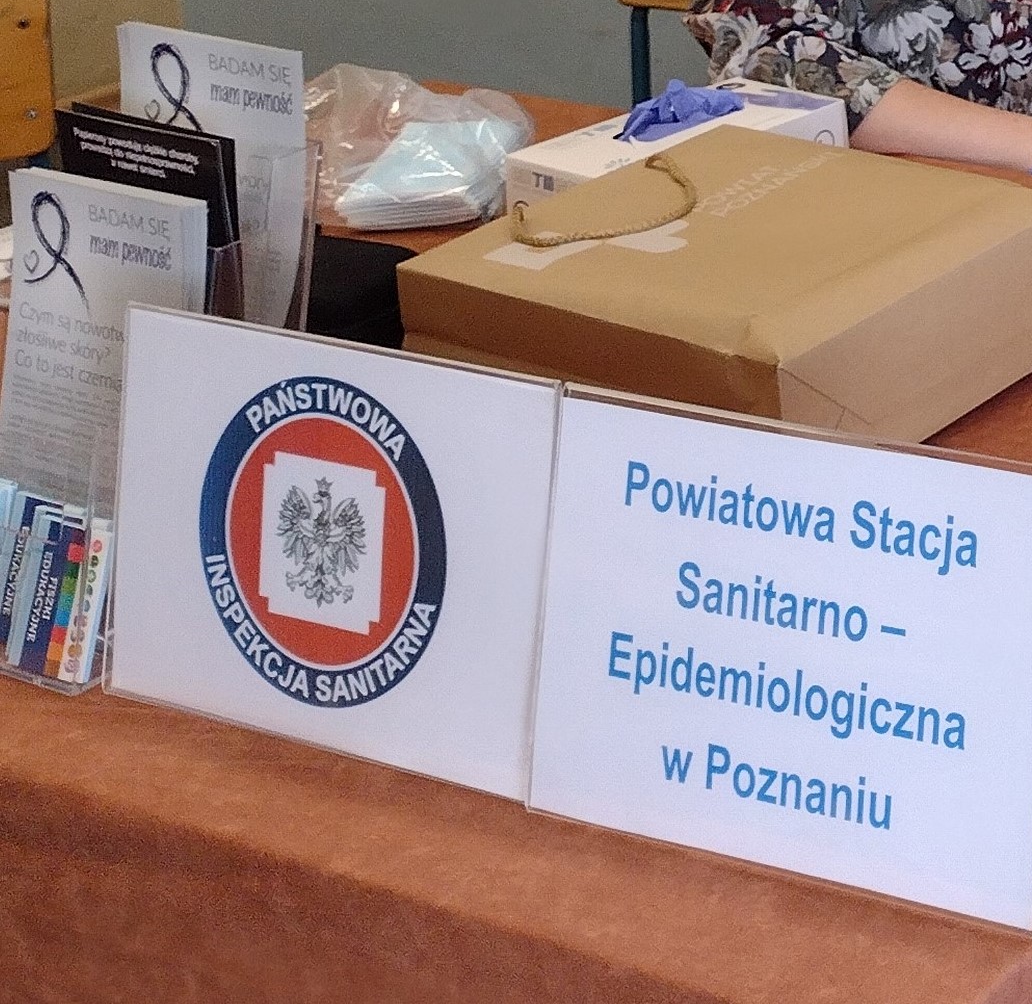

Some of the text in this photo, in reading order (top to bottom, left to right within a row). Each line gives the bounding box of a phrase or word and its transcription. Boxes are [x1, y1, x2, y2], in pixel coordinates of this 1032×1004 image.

[208, 53, 291, 88] BADAM SIĘ
[210, 83, 240, 105] mam
[88, 204, 170, 242] BADAM SIĘ
[90, 234, 119, 258] mam
[245, 381, 407, 462] PAŃSTWOWA
[624, 460, 978, 576] Powiatowa Stacja
[26, 551, 53, 644] EDUKACYJNE
[205, 554, 437, 703] INSPEKCJA SANITARNA
[676, 561, 868, 643] Sanitarno
[608, 631, 966, 750] Epidemiologiczna
[661, 744, 892, 831] w Poznaniu
